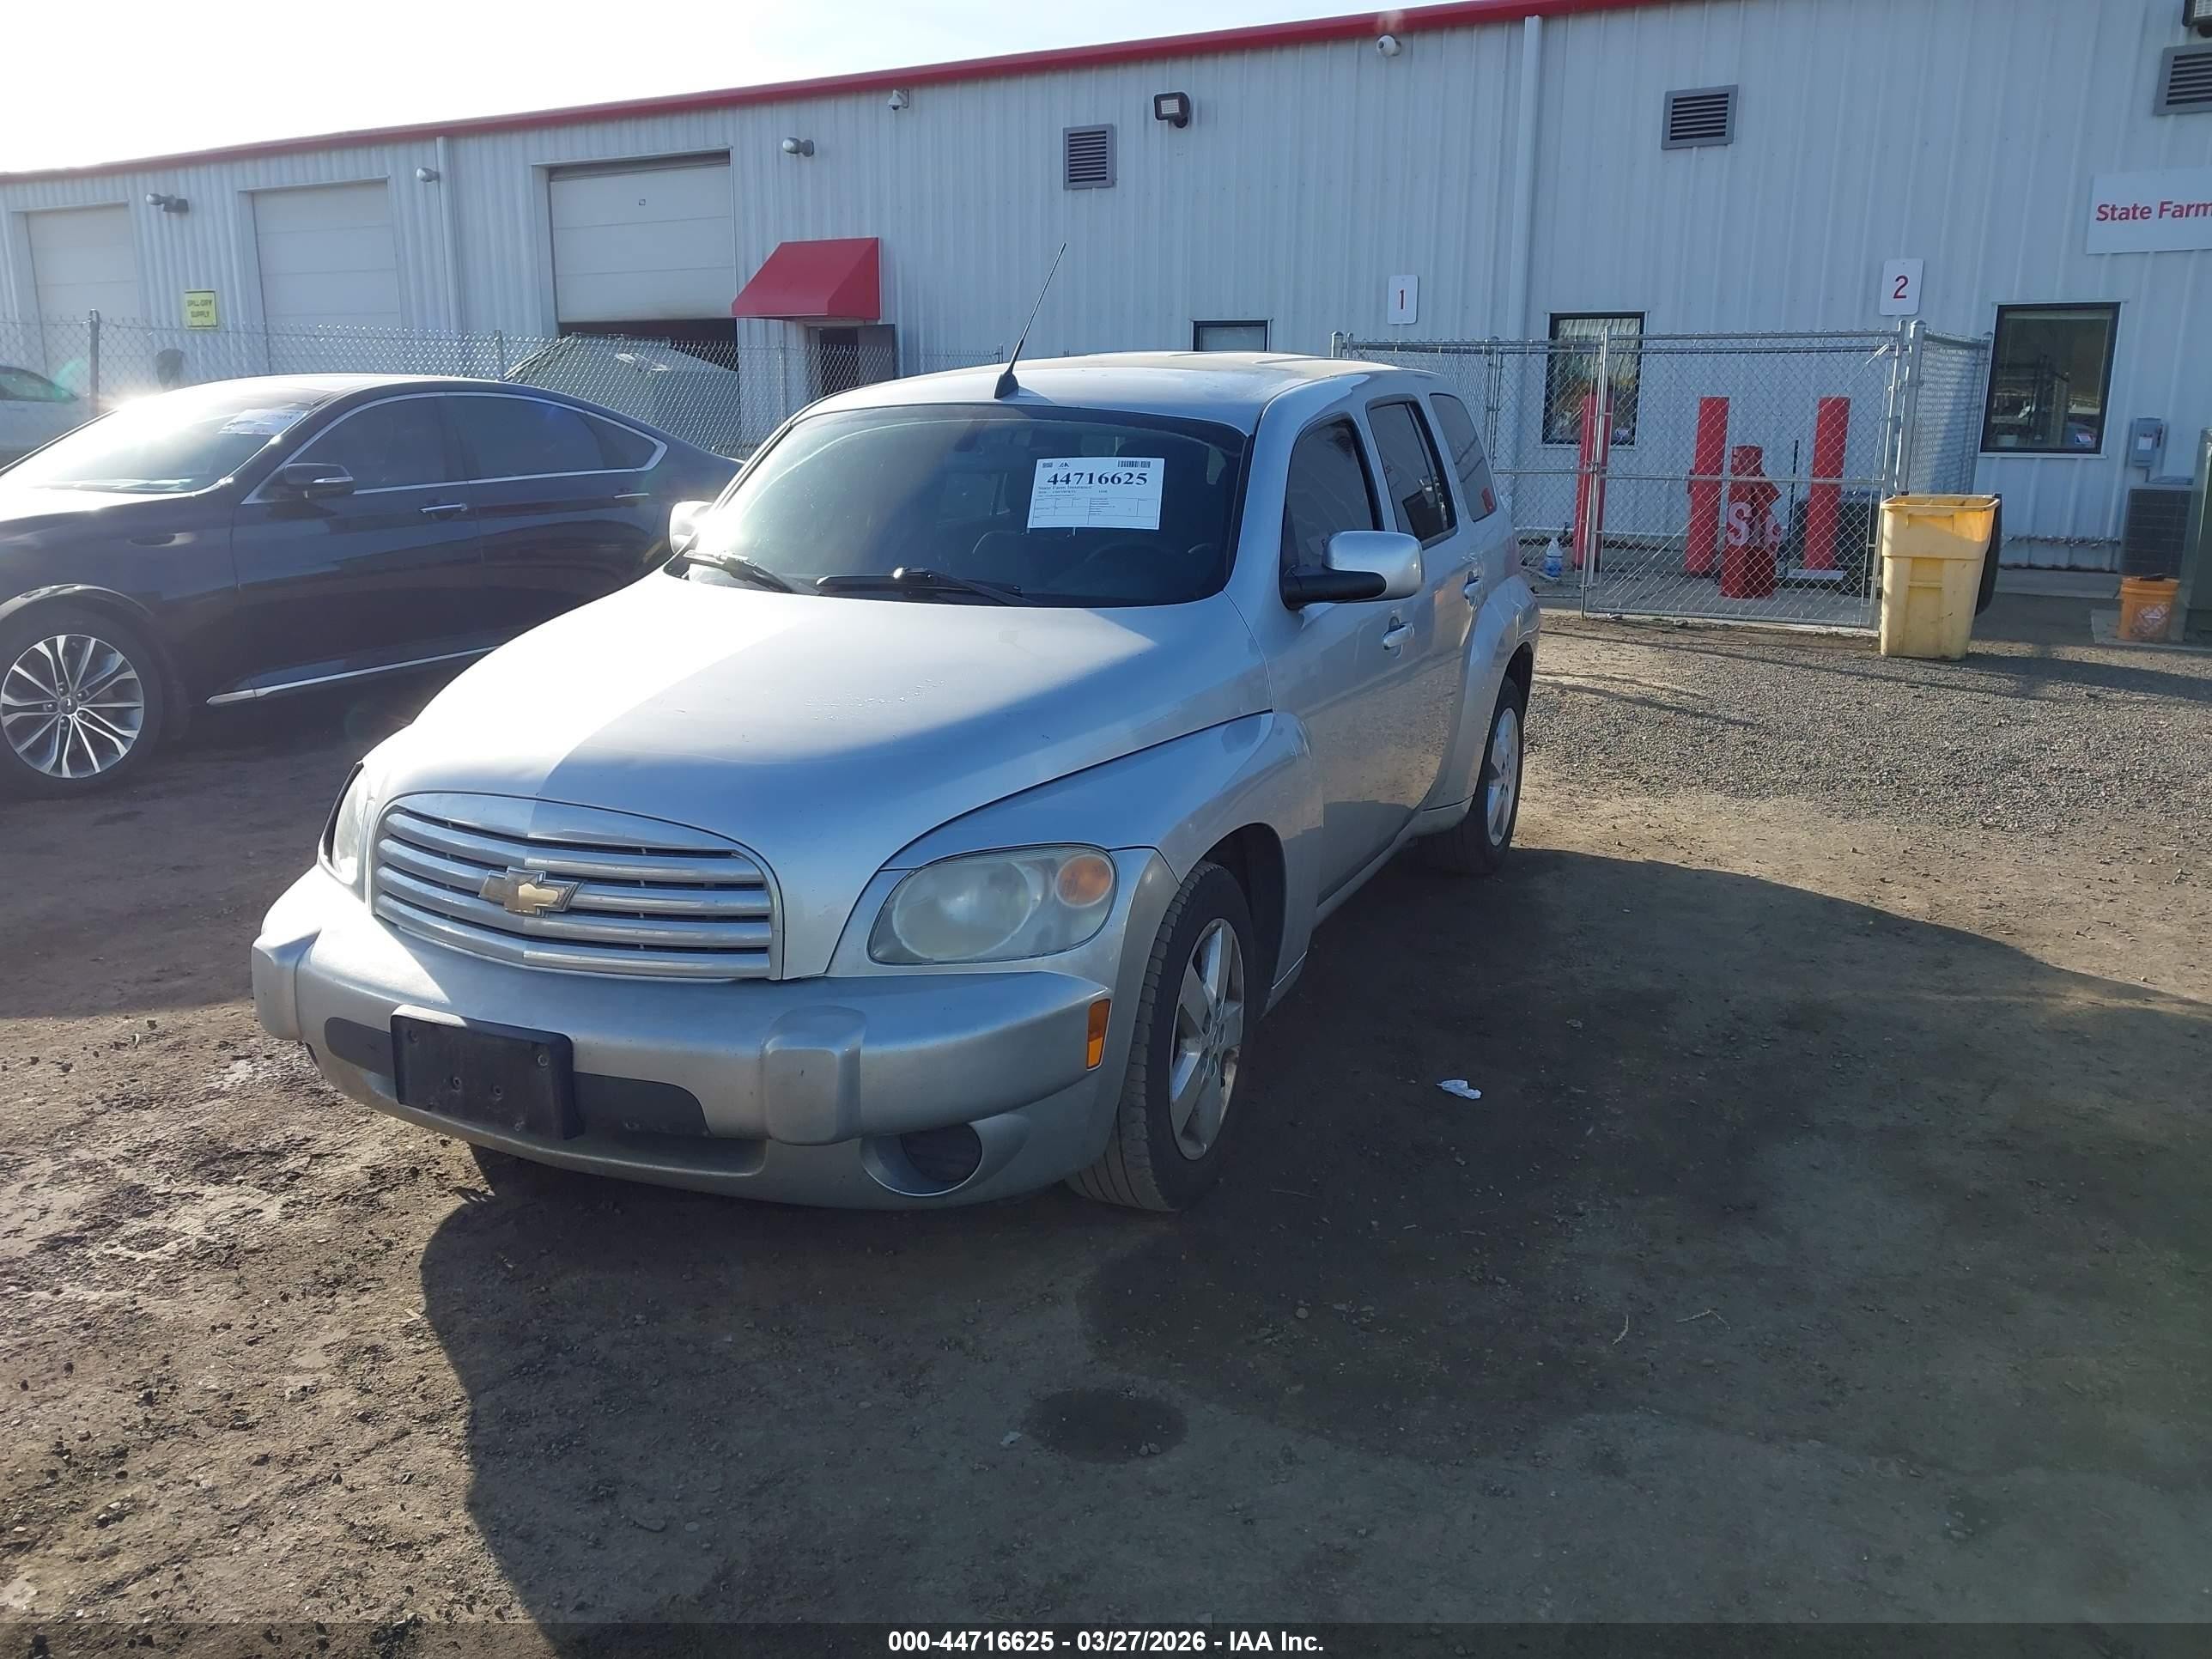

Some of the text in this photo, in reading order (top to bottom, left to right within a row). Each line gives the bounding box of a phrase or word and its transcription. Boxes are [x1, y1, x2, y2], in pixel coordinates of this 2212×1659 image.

[2096, 200, 2212, 222] State Farm
[1893, 275, 1909, 299] 2
[1399, 289, 1405, 310] 1
[1047, 471, 1148, 485] 44716625
